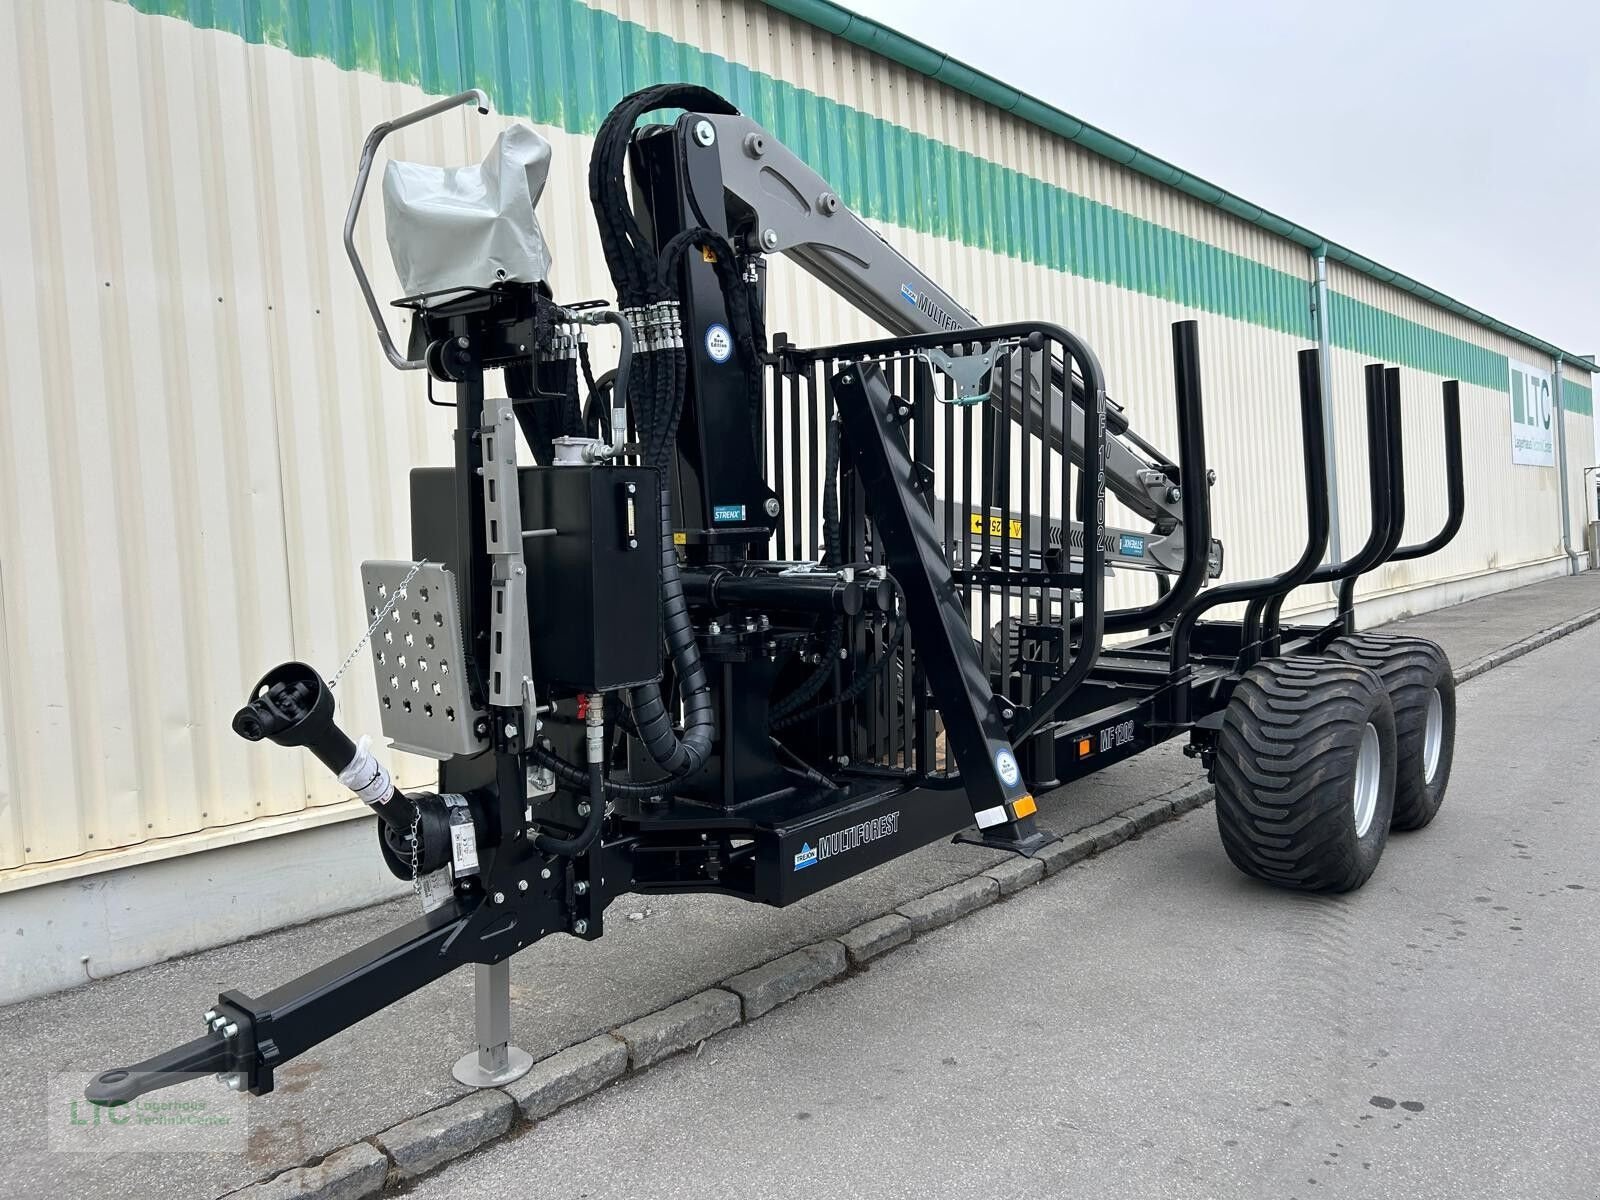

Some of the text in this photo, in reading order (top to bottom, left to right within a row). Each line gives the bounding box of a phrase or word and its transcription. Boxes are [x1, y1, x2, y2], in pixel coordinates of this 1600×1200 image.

[1525, 373, 1550, 430] LTC
[715, 510, 740, 519] STRENX
[1100, 726, 1115, 752] MF
[819, 811, 900, 861] MULTIFOREST
